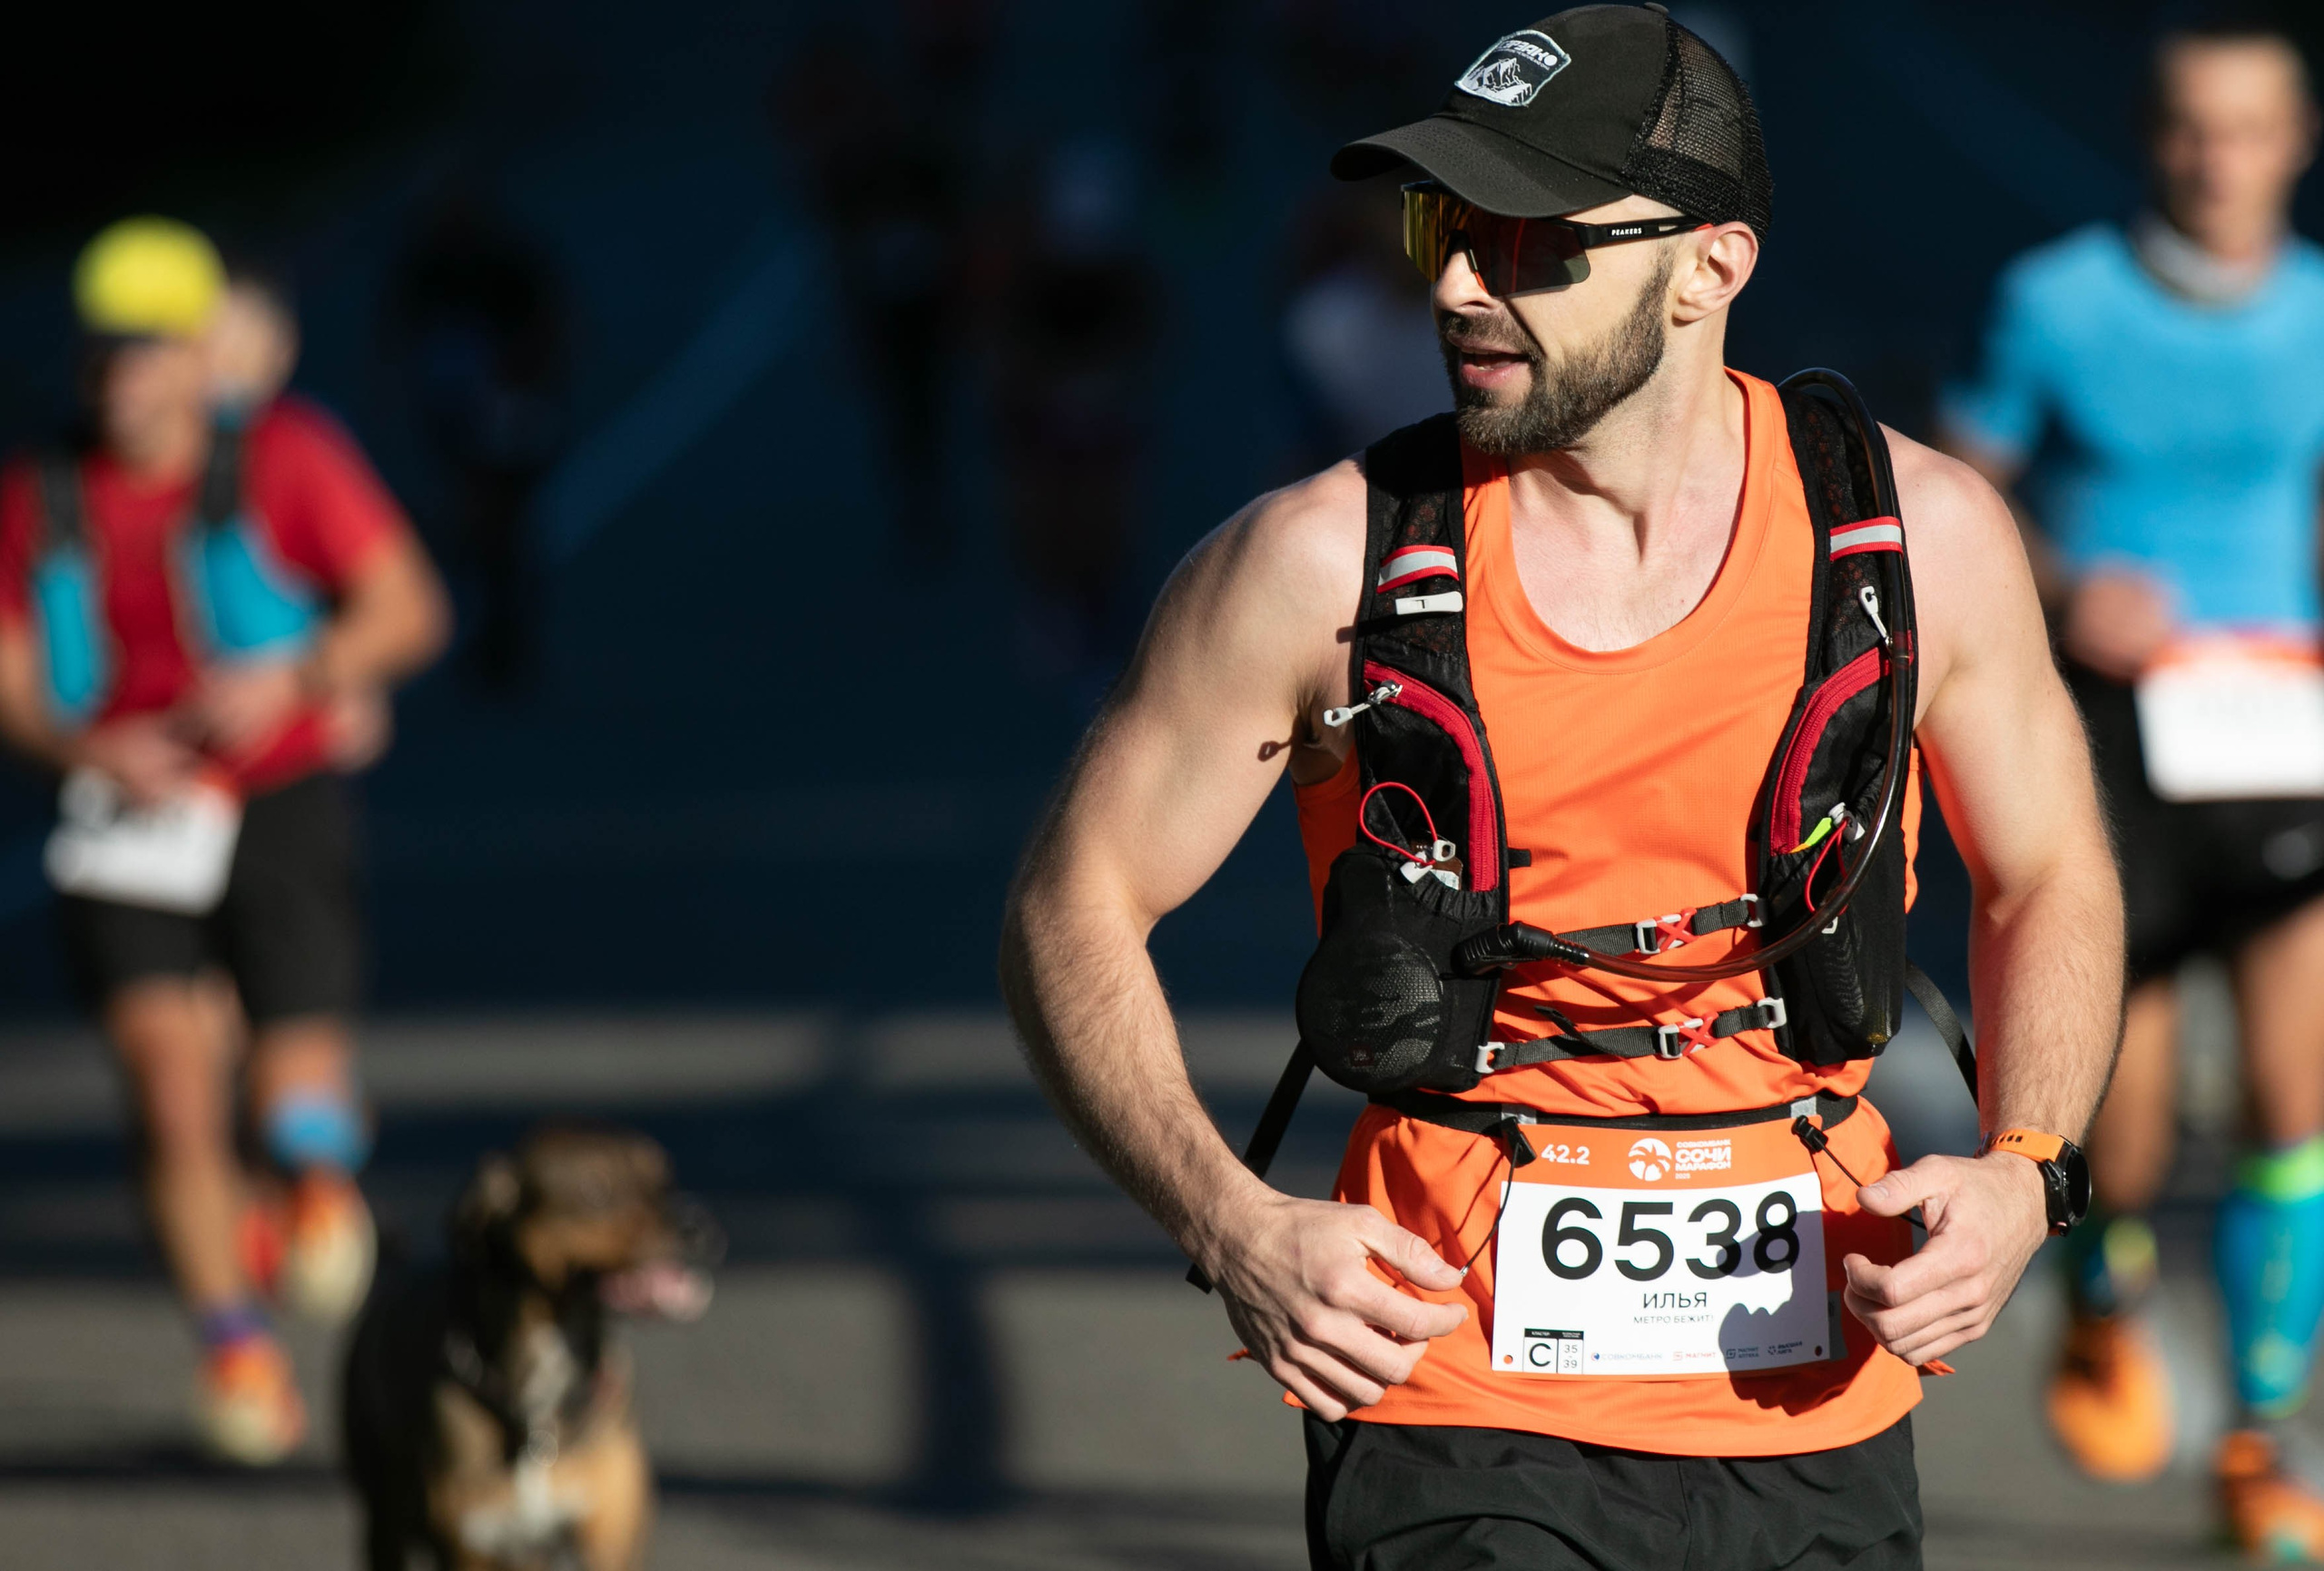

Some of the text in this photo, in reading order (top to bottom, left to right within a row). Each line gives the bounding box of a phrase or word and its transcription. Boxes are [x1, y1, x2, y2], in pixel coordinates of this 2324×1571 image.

[1611, 227, 1642, 236] PEAKERS
[1541, 1144, 1590, 1165] 42.2
[1675, 1145, 1732, 1164] СОЧИ
[1675, 1161, 1732, 1172] МАРАФОН
[1541, 1191, 1800, 1281] 6538
[1643, 1291, 1708, 1309] ИЛЬЯ
[1633, 1314, 1714, 1324] МЕТРО БЕЖИТ!
[1563, 1344, 1578, 1354] 35
[1563, 1360, 1578, 1369] 39
